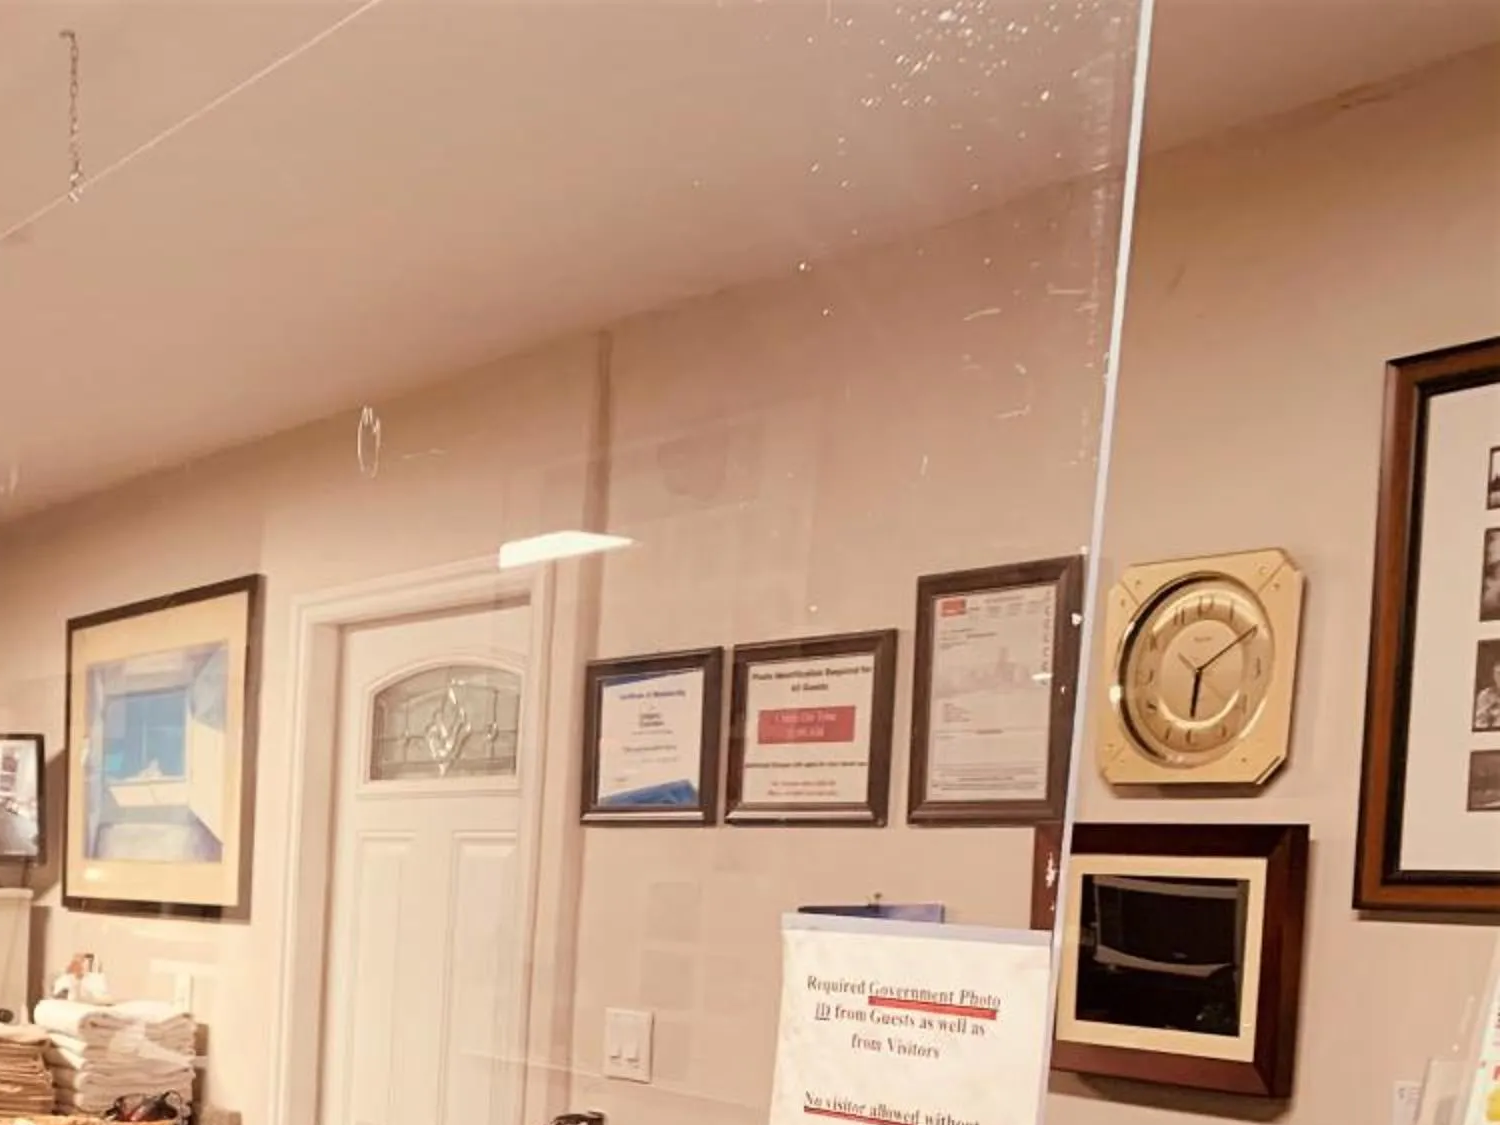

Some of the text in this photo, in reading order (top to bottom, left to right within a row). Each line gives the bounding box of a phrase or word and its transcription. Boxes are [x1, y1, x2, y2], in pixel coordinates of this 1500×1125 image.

[807, 975, 1001, 1009] Required Government Photo
[815, 1003, 985, 1036] ID from Guests as well as
[851, 1033, 940, 1059] from Visitors
[805, 1090, 822, 1106] No
[825, 1095, 866, 1114] visitor
[869, 1103, 920, 1125] allowed
